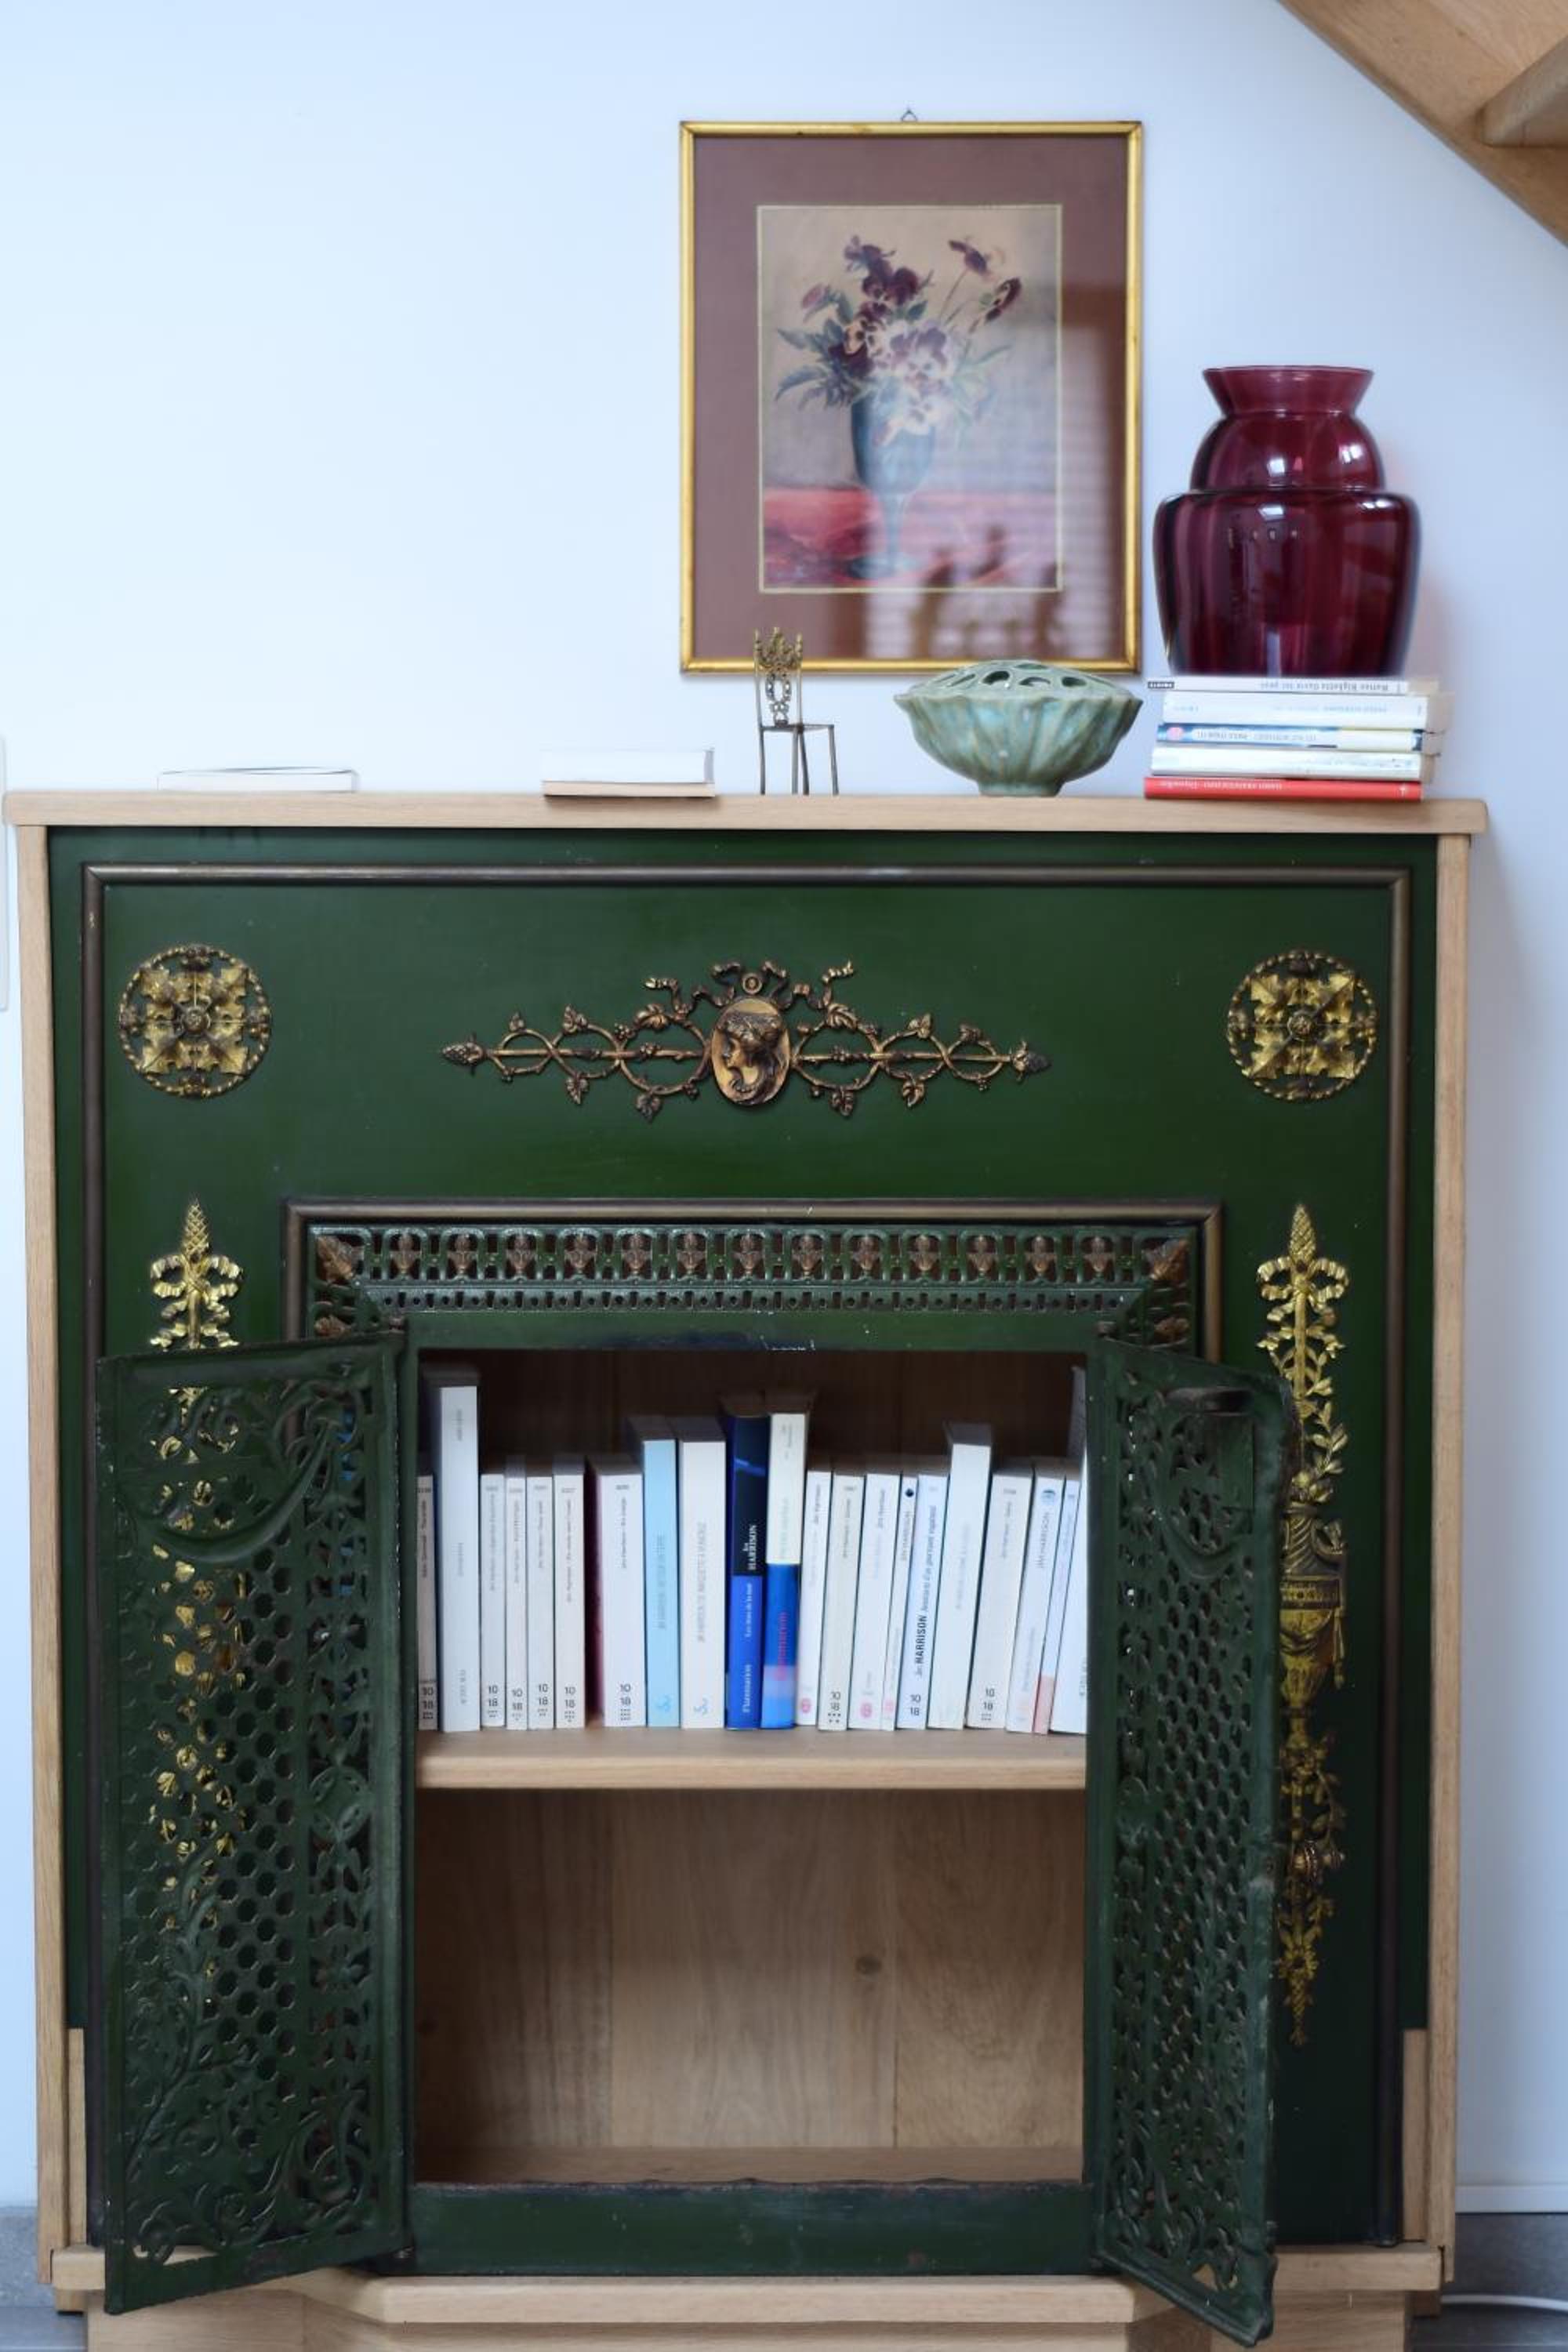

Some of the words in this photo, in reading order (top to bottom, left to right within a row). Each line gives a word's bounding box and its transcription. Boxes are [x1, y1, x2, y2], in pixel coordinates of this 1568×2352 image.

[747, 1524, 757, 1570] HARRISON
[915, 1615, 927, 1664] HARRISON
[488, 1685, 498, 1694] 10
[511, 1687, 523, 1697] 10
[539, 1683, 548, 1693] 10
[564, 1686, 576, 1695] 10
[619, 1683, 631, 1693] 10
[985, 1687, 995, 1697] 10
[830, 1691, 841, 1700] 10
[909, 1693, 921, 1703] 10
[488, 1698, 498, 1708] 18
[539, 1696, 548, 1706] 18
[564, 1699, 576, 1708] 18
[619, 1697, 631, 1706] 18
[983, 1701, 993, 1711] 18
[830, 1702, 840, 1711] 18
[909, 1706, 920, 1716] 18
